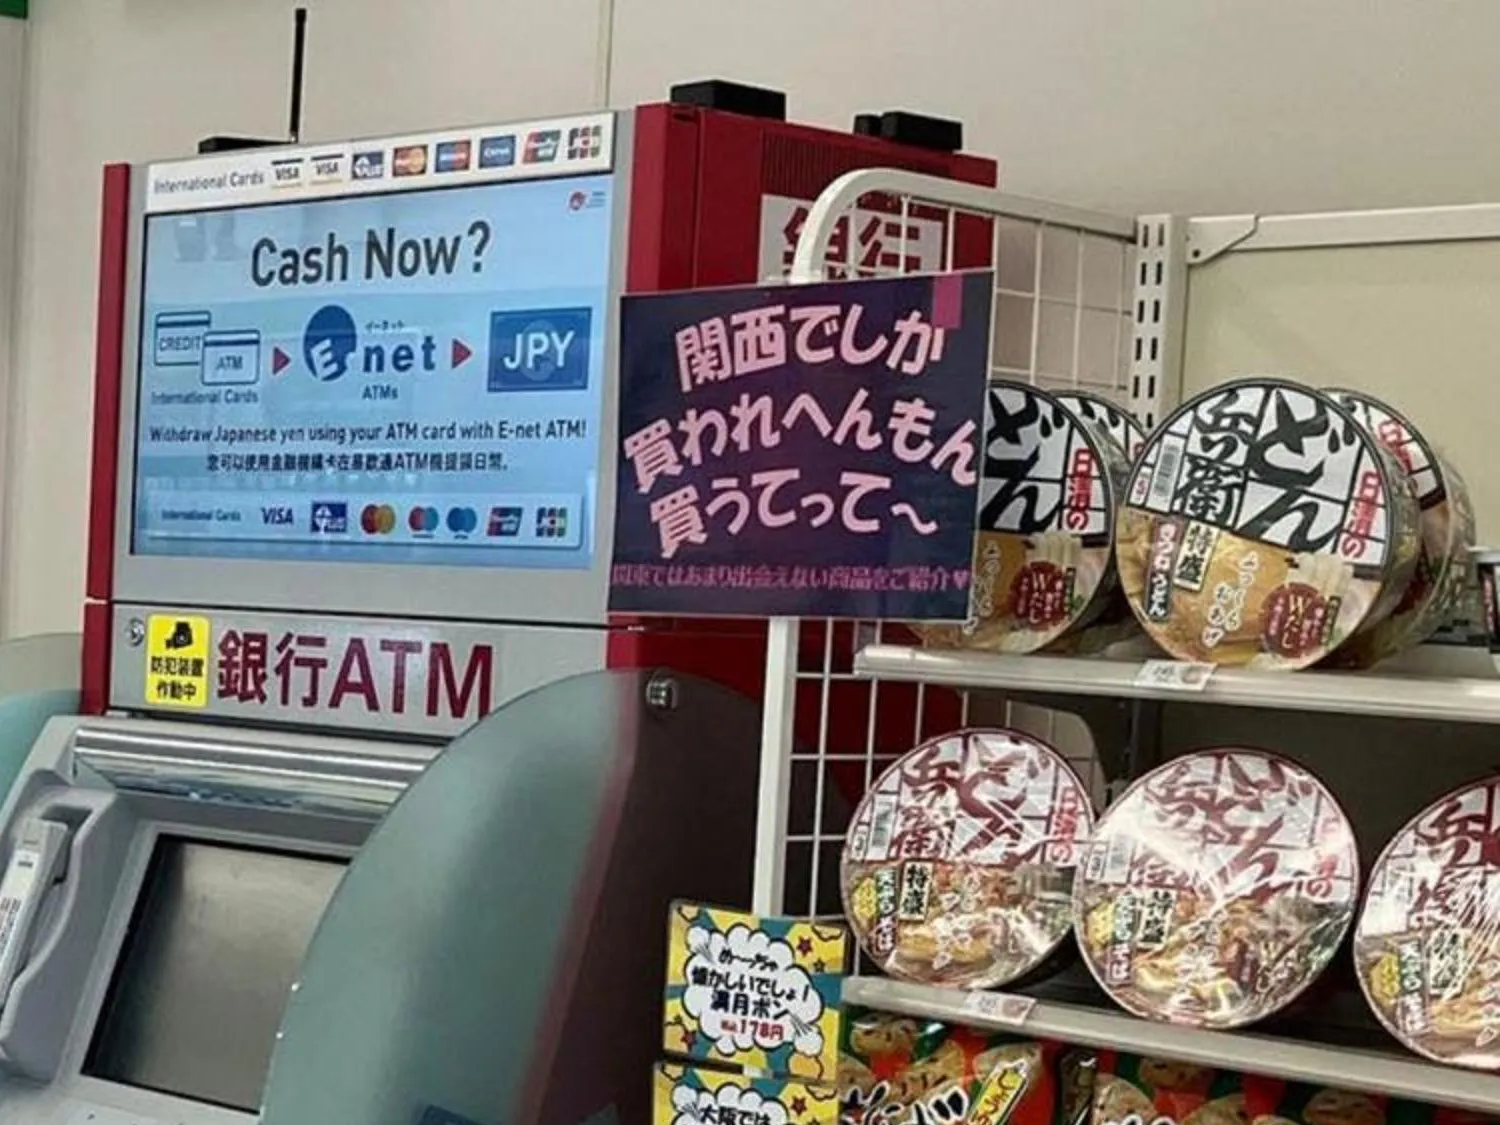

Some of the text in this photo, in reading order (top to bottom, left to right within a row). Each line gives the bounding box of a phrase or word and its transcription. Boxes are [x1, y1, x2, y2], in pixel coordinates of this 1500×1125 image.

[275, 161, 339, 181] VISA VISA
[154, 170, 265, 194] International Cards
[251, 233, 349, 287] Cash
[158, 335, 199, 351] CREDIT
[502, 329, 575, 371] JPY
[675, 304, 946, 393] 関西でしか
[216, 355, 244, 371] ATM
[151, 390, 259, 404] International Cards
[361, 383, 399, 401] ATMs
[149, 418, 587, 444] Withdraw Japanese yen using your ATM card with E-net ATM!
[622, 388, 978, 494] 買われへんもん
[162, 508, 241, 522] International Cards
[260, 507, 294, 525] VISA
[151, 656, 204, 678] 防犯装置
[217, 629, 494, 720] 銀行ATM
[156, 681, 197, 700] 作動中
